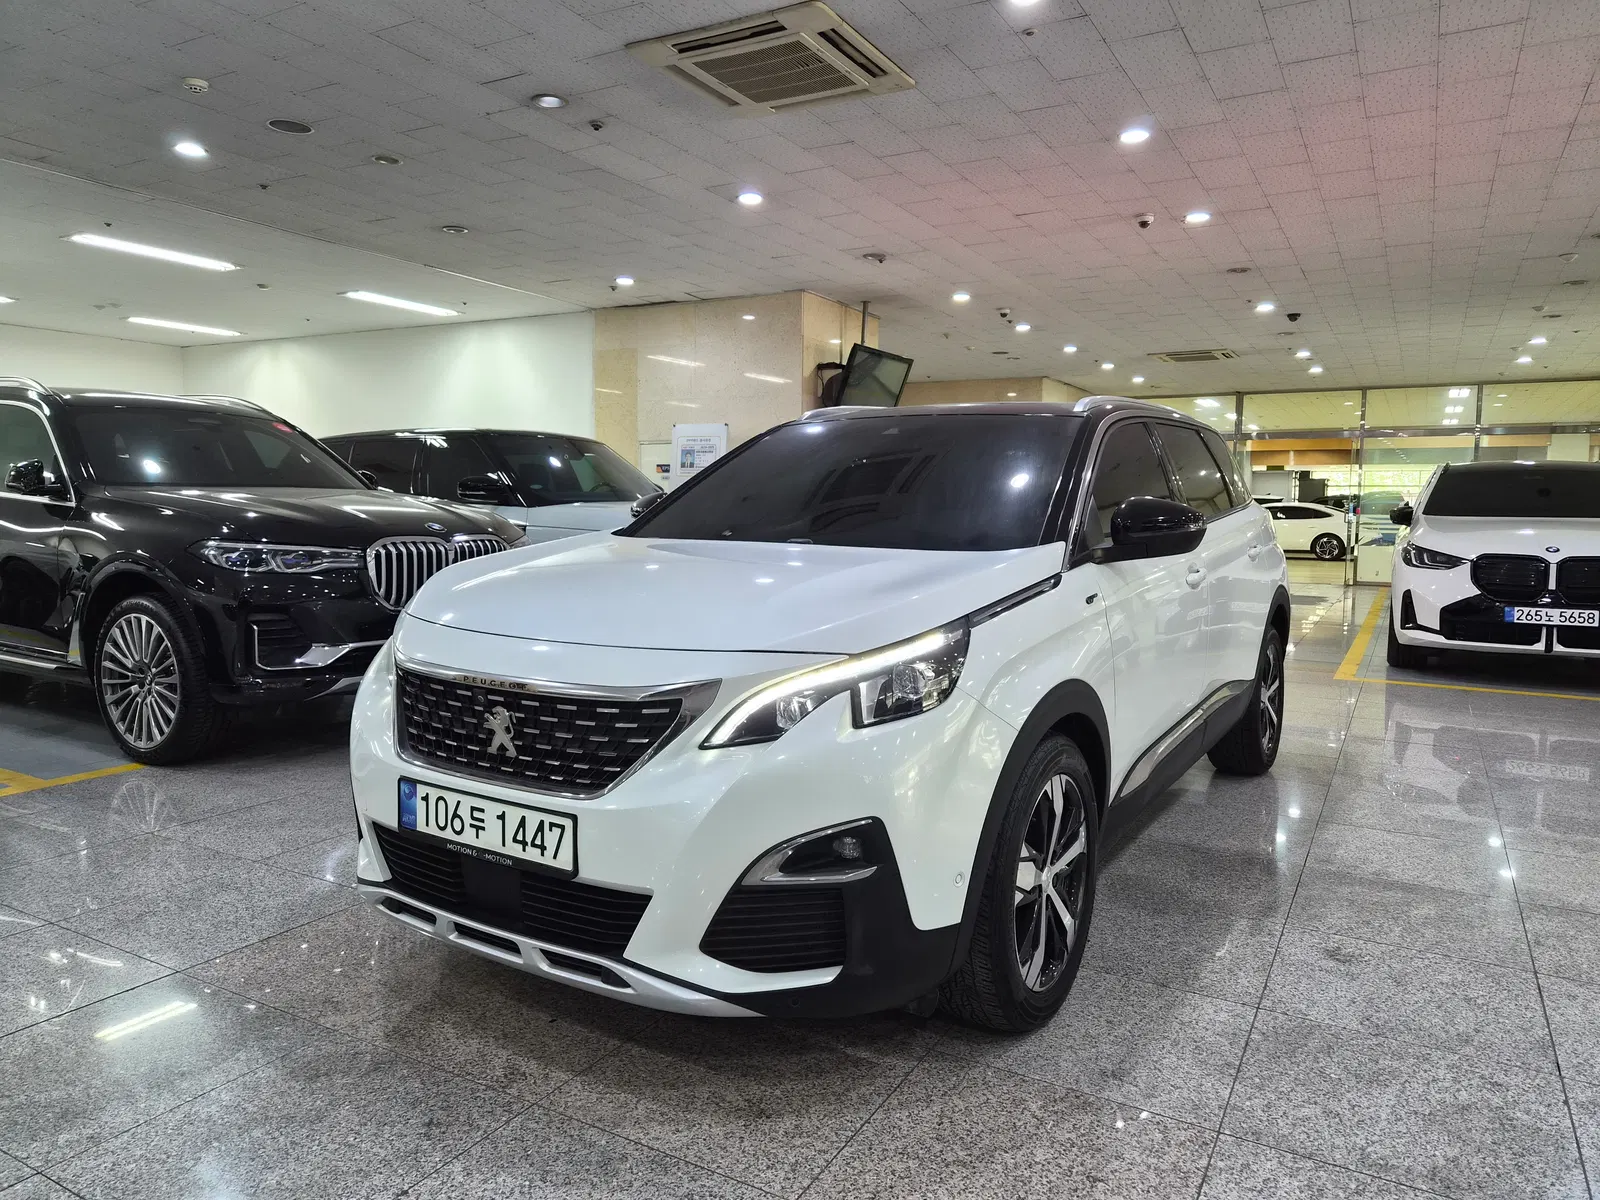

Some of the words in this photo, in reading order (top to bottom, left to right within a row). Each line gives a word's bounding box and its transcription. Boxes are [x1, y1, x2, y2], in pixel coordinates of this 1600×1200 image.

[1516, 609, 1554, 622] 265노
[1559, 611, 1595, 624] 5658
[420, 792, 485, 839] 106두
[496, 810, 565, 860] 1447
[447, 843, 472, 856] MOTION
